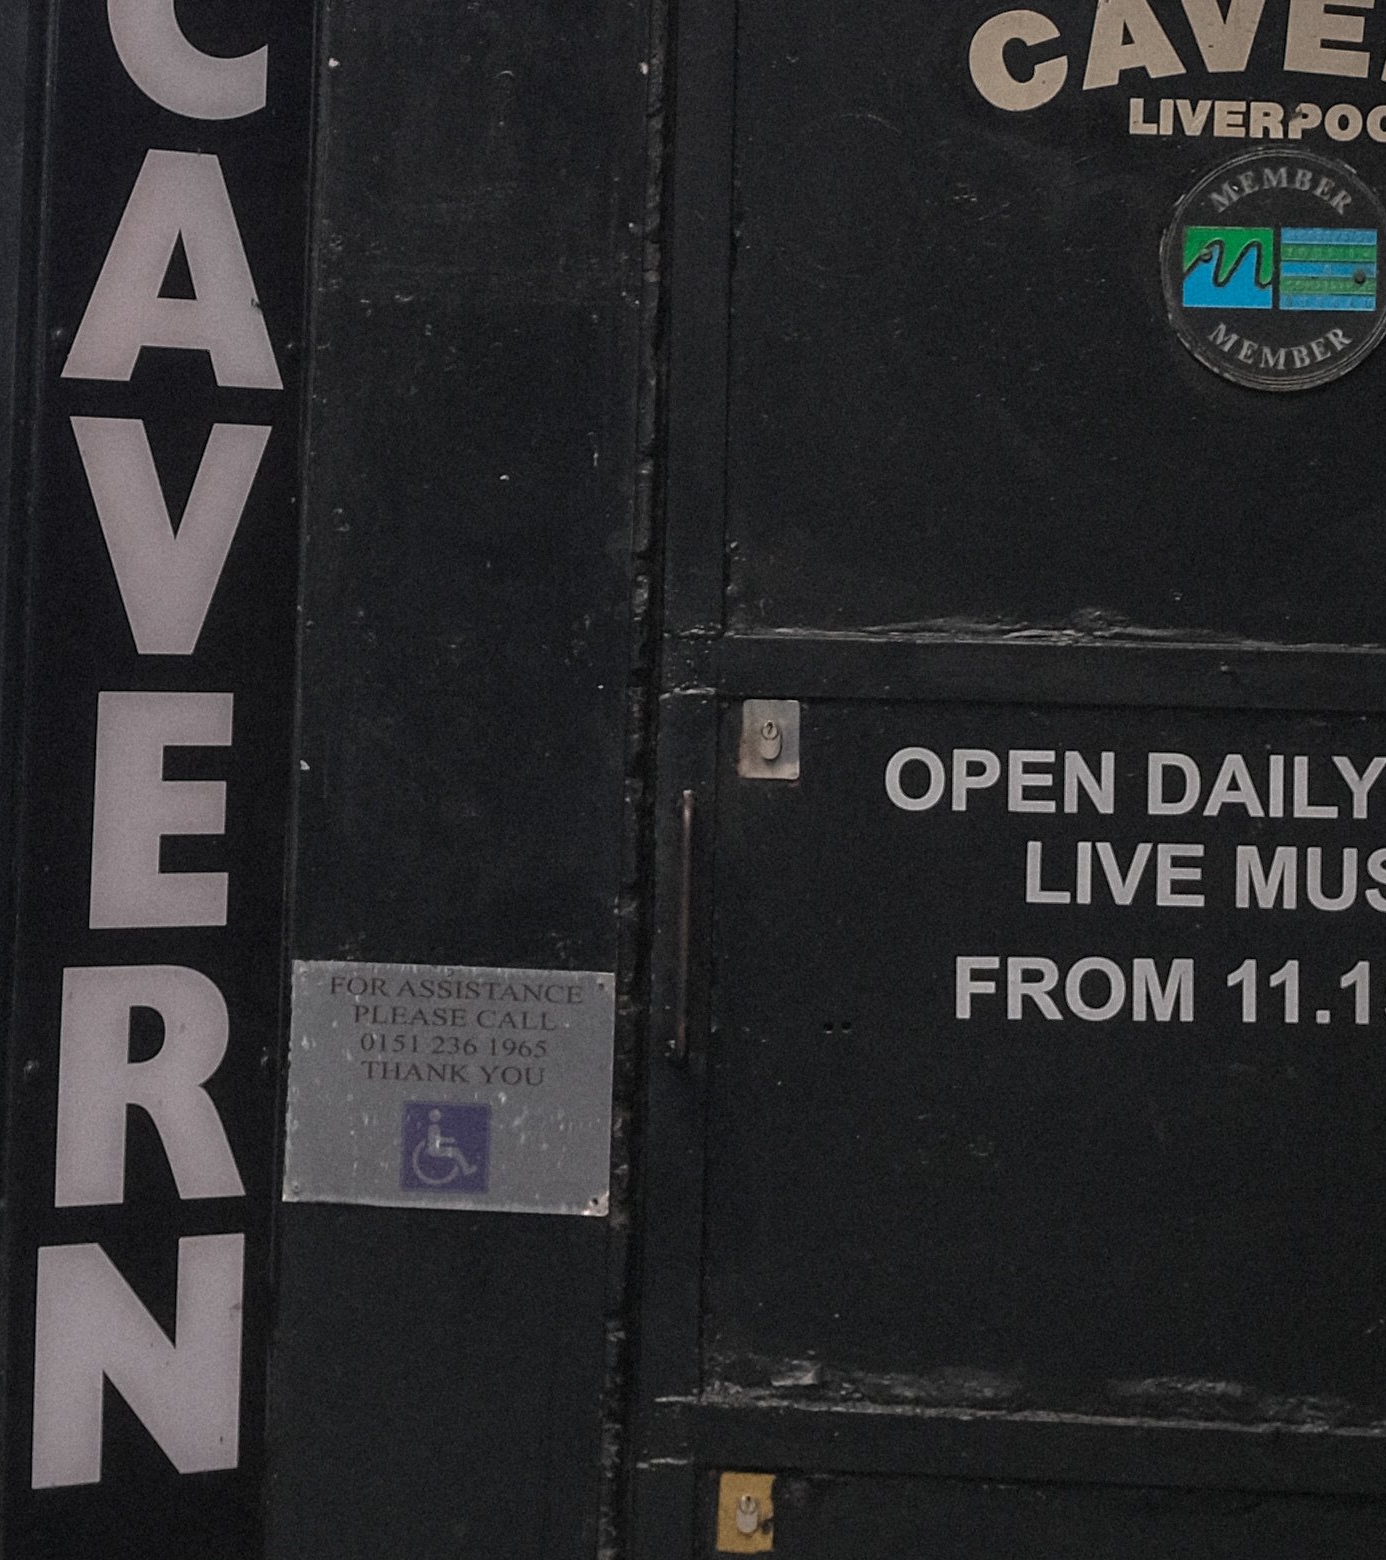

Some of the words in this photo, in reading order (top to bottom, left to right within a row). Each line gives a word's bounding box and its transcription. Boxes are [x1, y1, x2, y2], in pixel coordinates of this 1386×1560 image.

[1210, 165, 1353, 215] MEMBER
[1207, 322, 1353, 372] MEMBER
[884, 746, 1116, 816] OPEN
[1025, 840, 1205, 908] LIVE
[330, 976, 389, 998] FOR
[397, 980, 584, 1005] ASSISTANCE
[955, 956, 1196, 1023] FROM
[354, 1005, 467, 1029] PLEASE
[477, 1009, 558, 1031] CALL
[360, 1033, 418, 1054] 0151
[432, 1035, 478, 1055] 236
[490, 1038, 548, 1058] 1965
[361, 1061, 470, 1084] THANK
[480, 1066, 545, 1086] YOU
